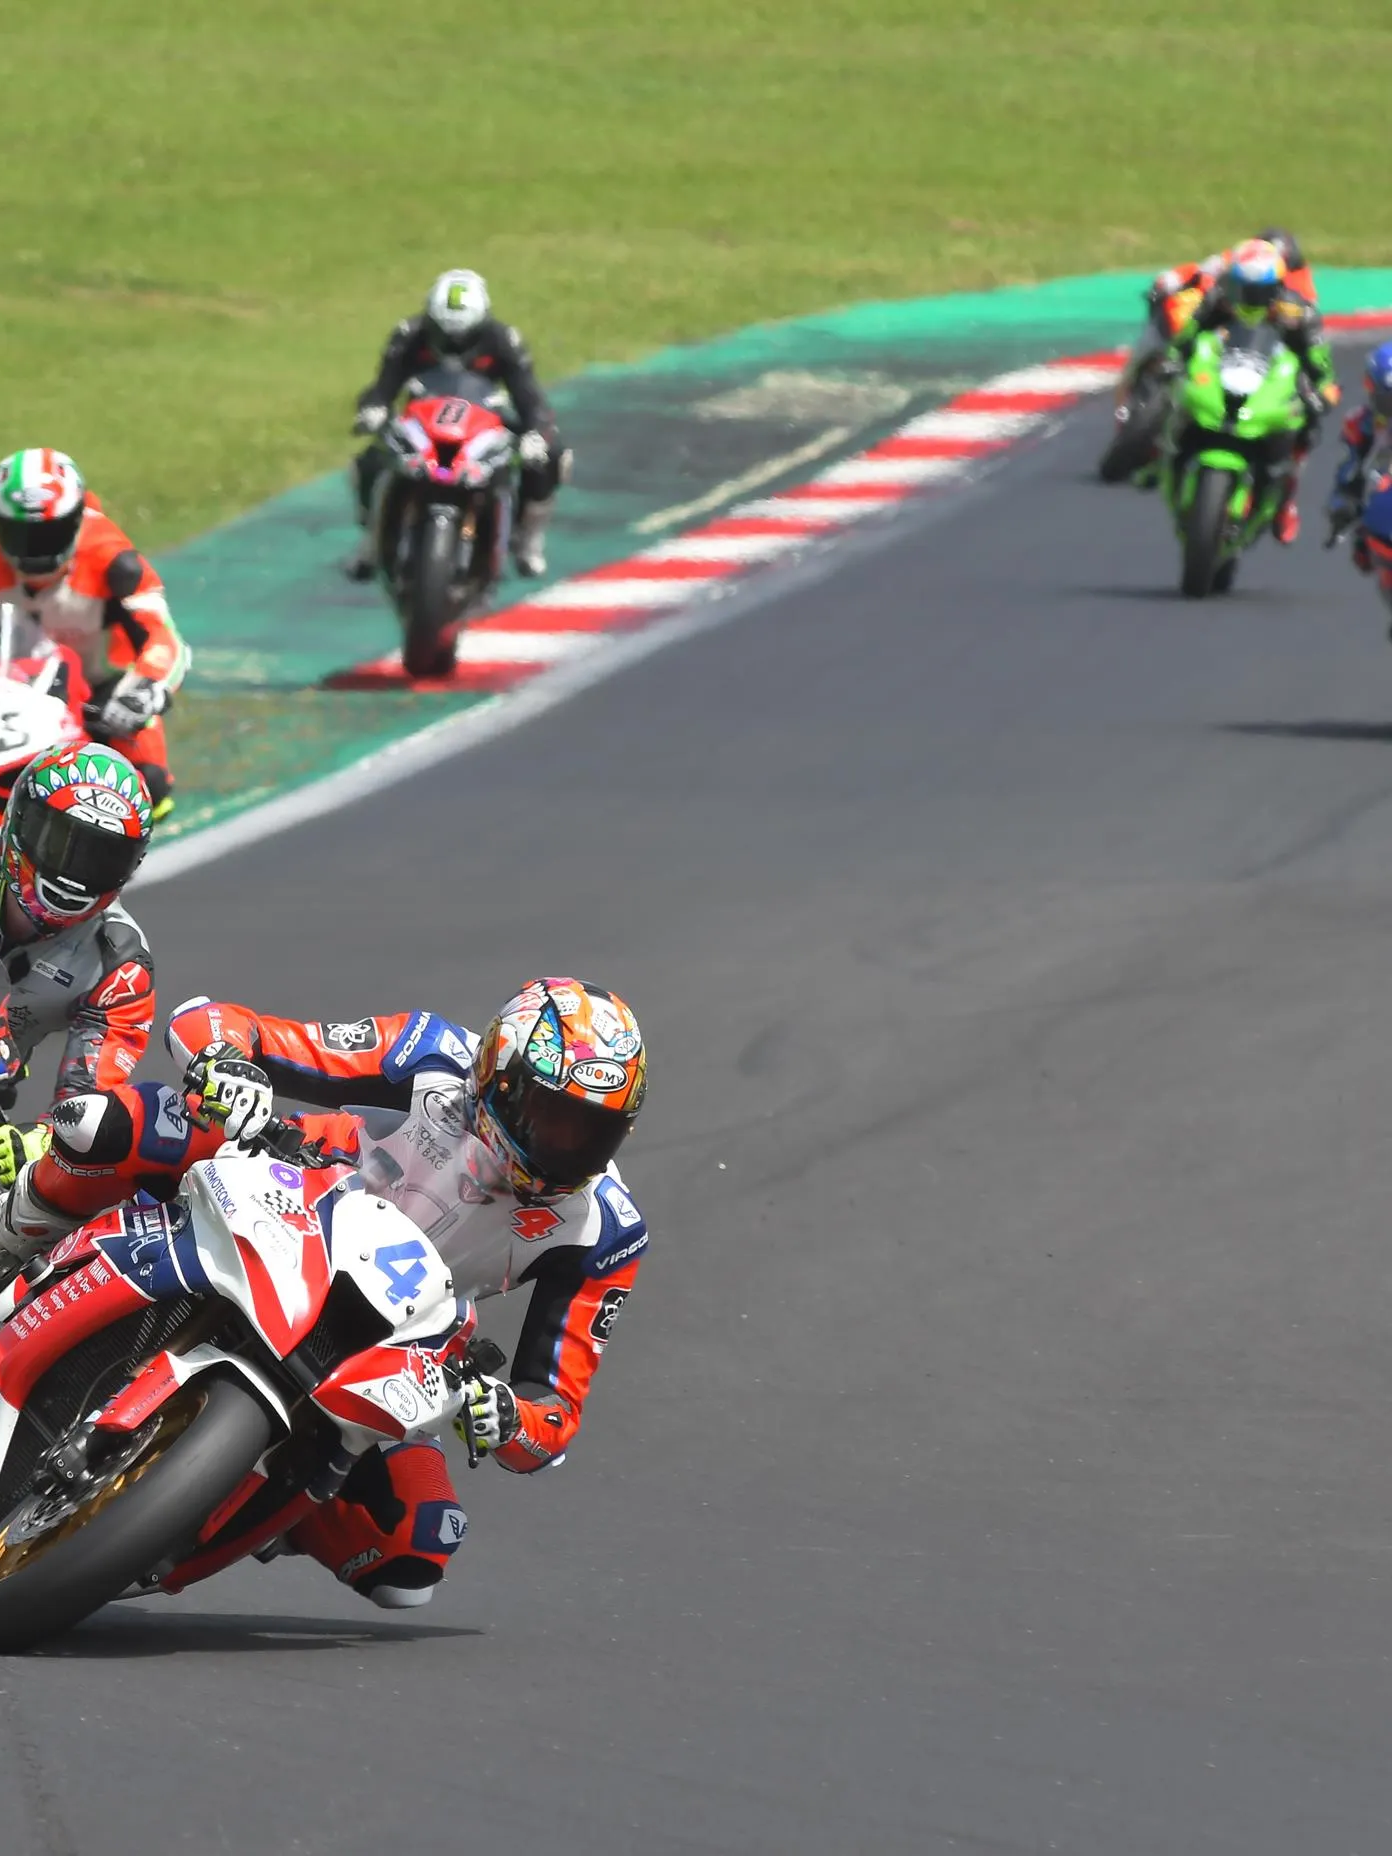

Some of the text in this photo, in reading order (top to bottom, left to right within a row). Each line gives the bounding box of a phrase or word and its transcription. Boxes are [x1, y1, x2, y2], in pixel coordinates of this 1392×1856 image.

[395, 1011, 431, 1067] VIRCOS
[540, 1049, 559, 1064] 50
[577, 1064, 624, 1090] SUOMY
[202, 1160, 237, 1219] TERMOTECNICA
[510, 1206, 566, 1242] 4
[88, 1259, 111, 1286] THANKS
[374, 1240, 437, 1305] 4
[388, 1382, 413, 1408] SPEEDY
